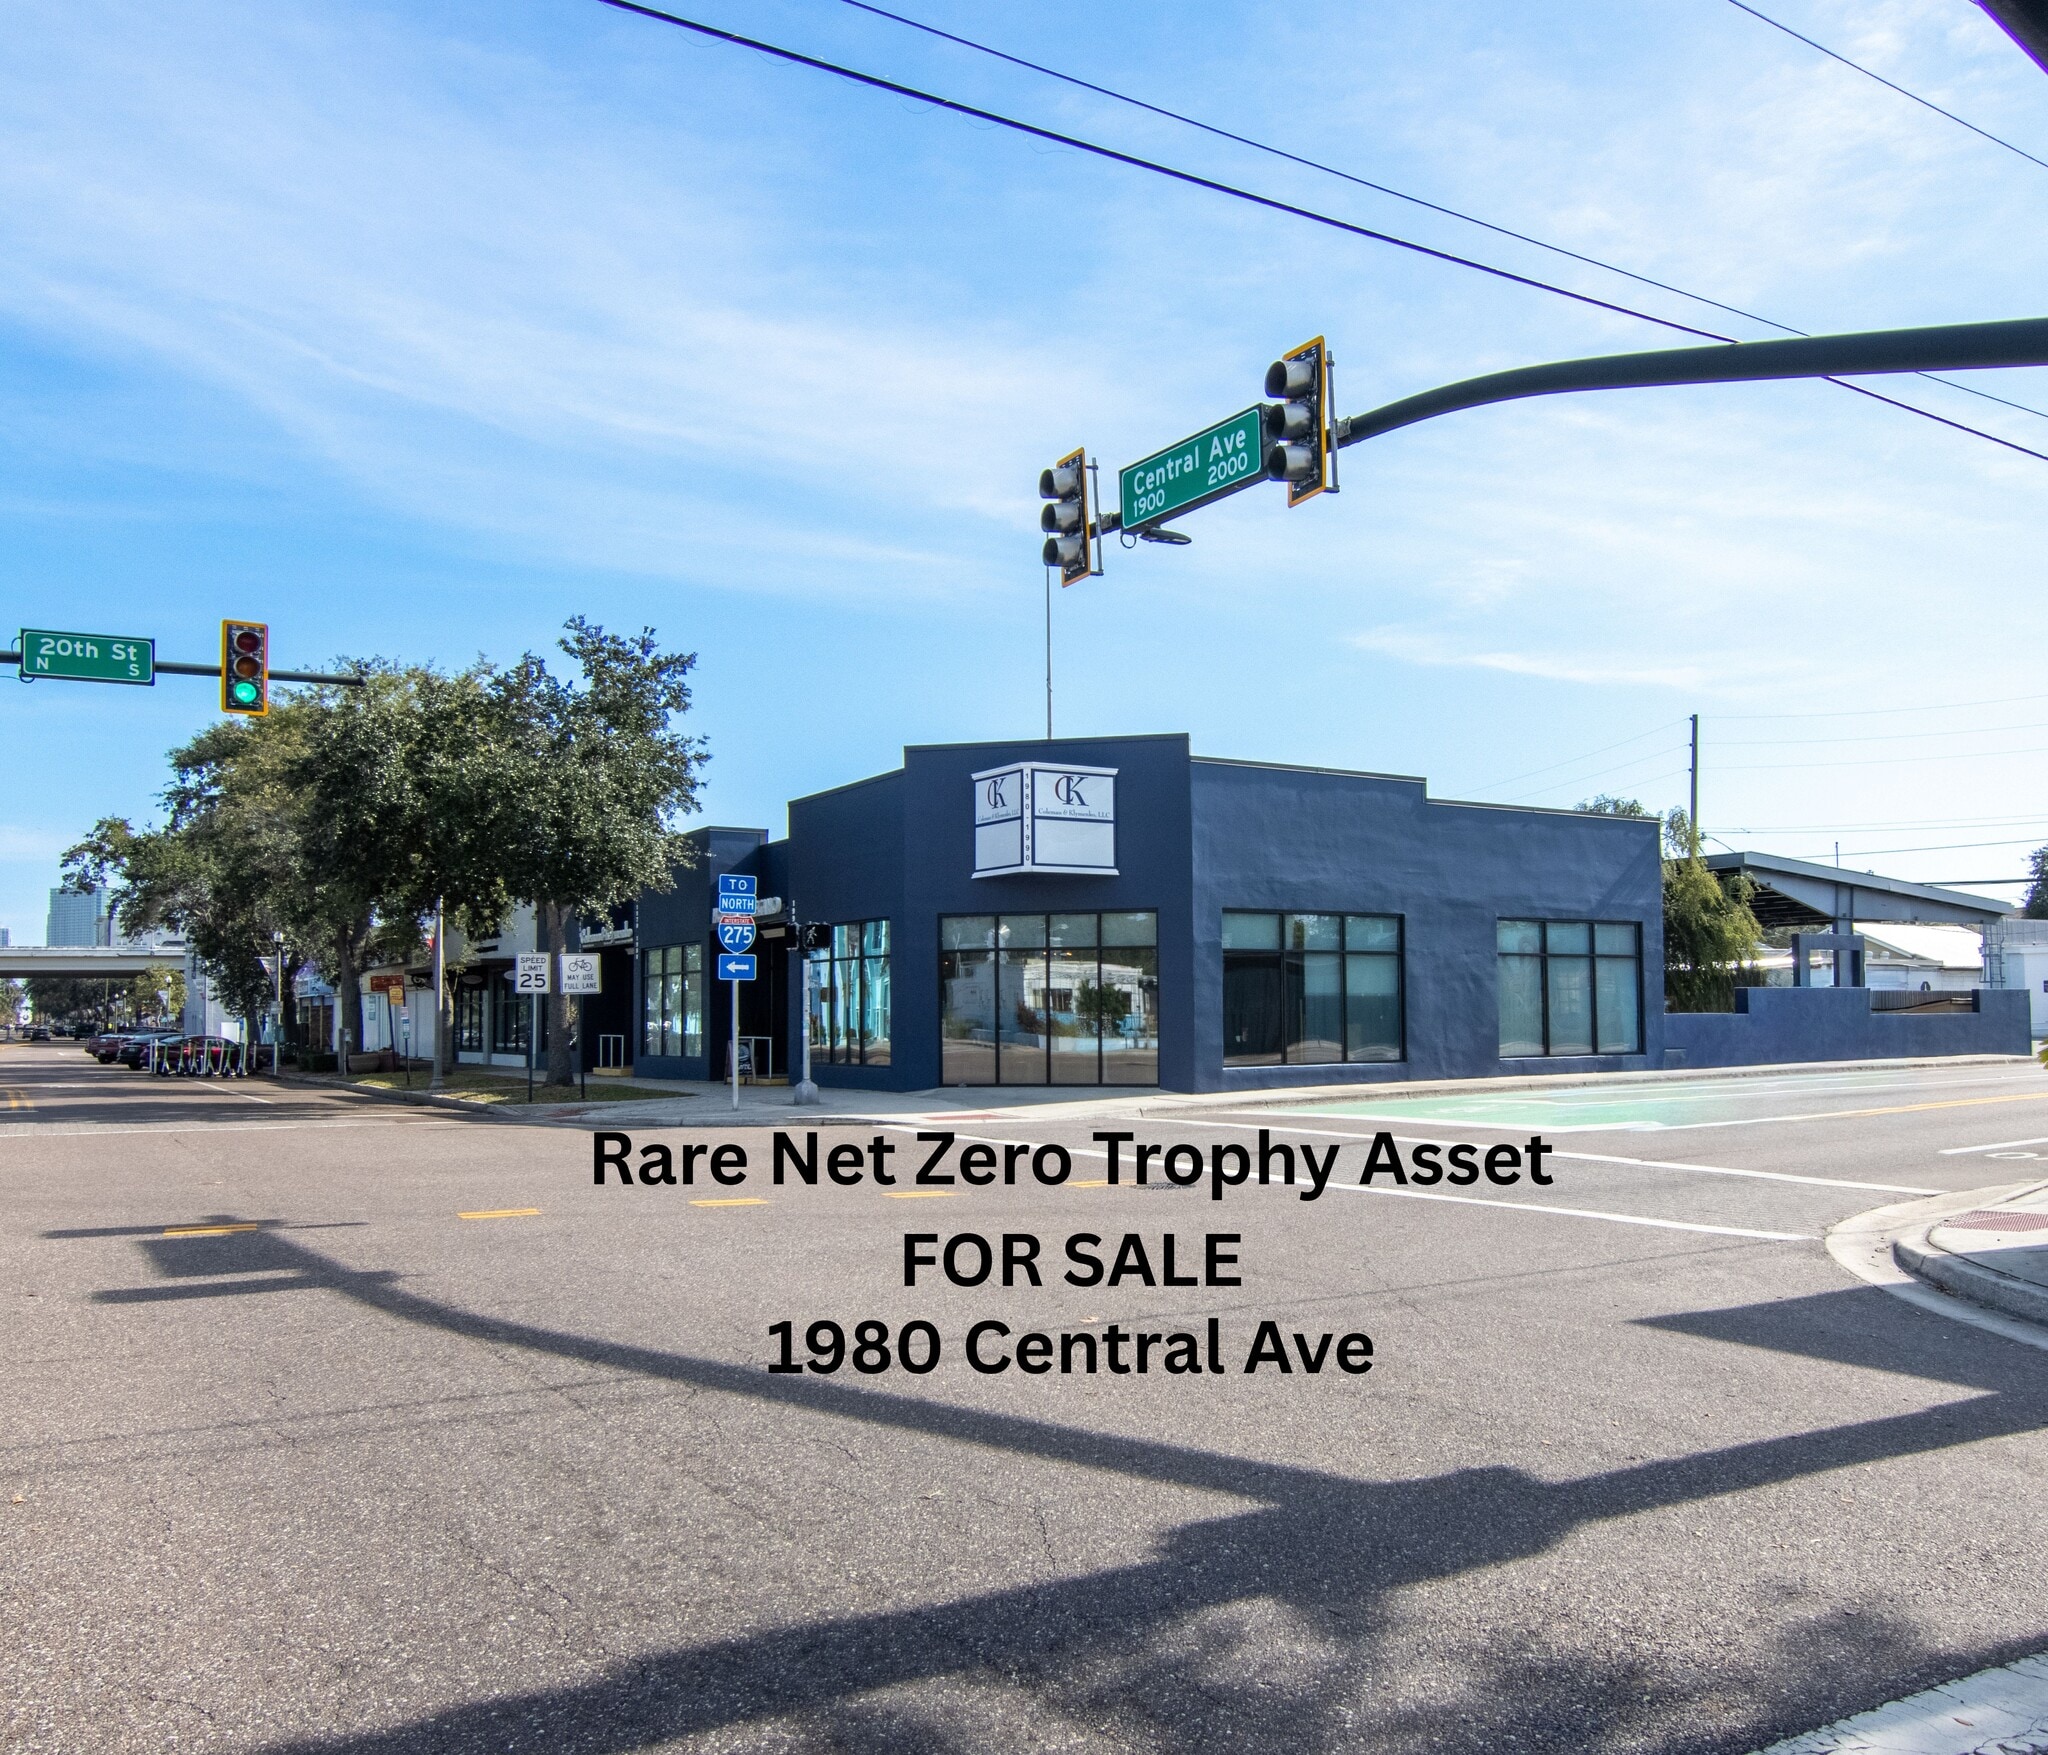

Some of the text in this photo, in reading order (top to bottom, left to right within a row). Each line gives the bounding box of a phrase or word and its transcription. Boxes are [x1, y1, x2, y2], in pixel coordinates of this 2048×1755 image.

[1133, 429, 1246, 495] Central Ave
[1133, 452, 1248, 517] 1900 2000
[39, 638, 137, 661] 20th St
[36, 657, 140, 677] N S
[729, 879, 748, 890] TO
[721, 898, 754, 910] NORTH
[724, 926, 752, 944] 275
[520, 973, 546, 988] 25
